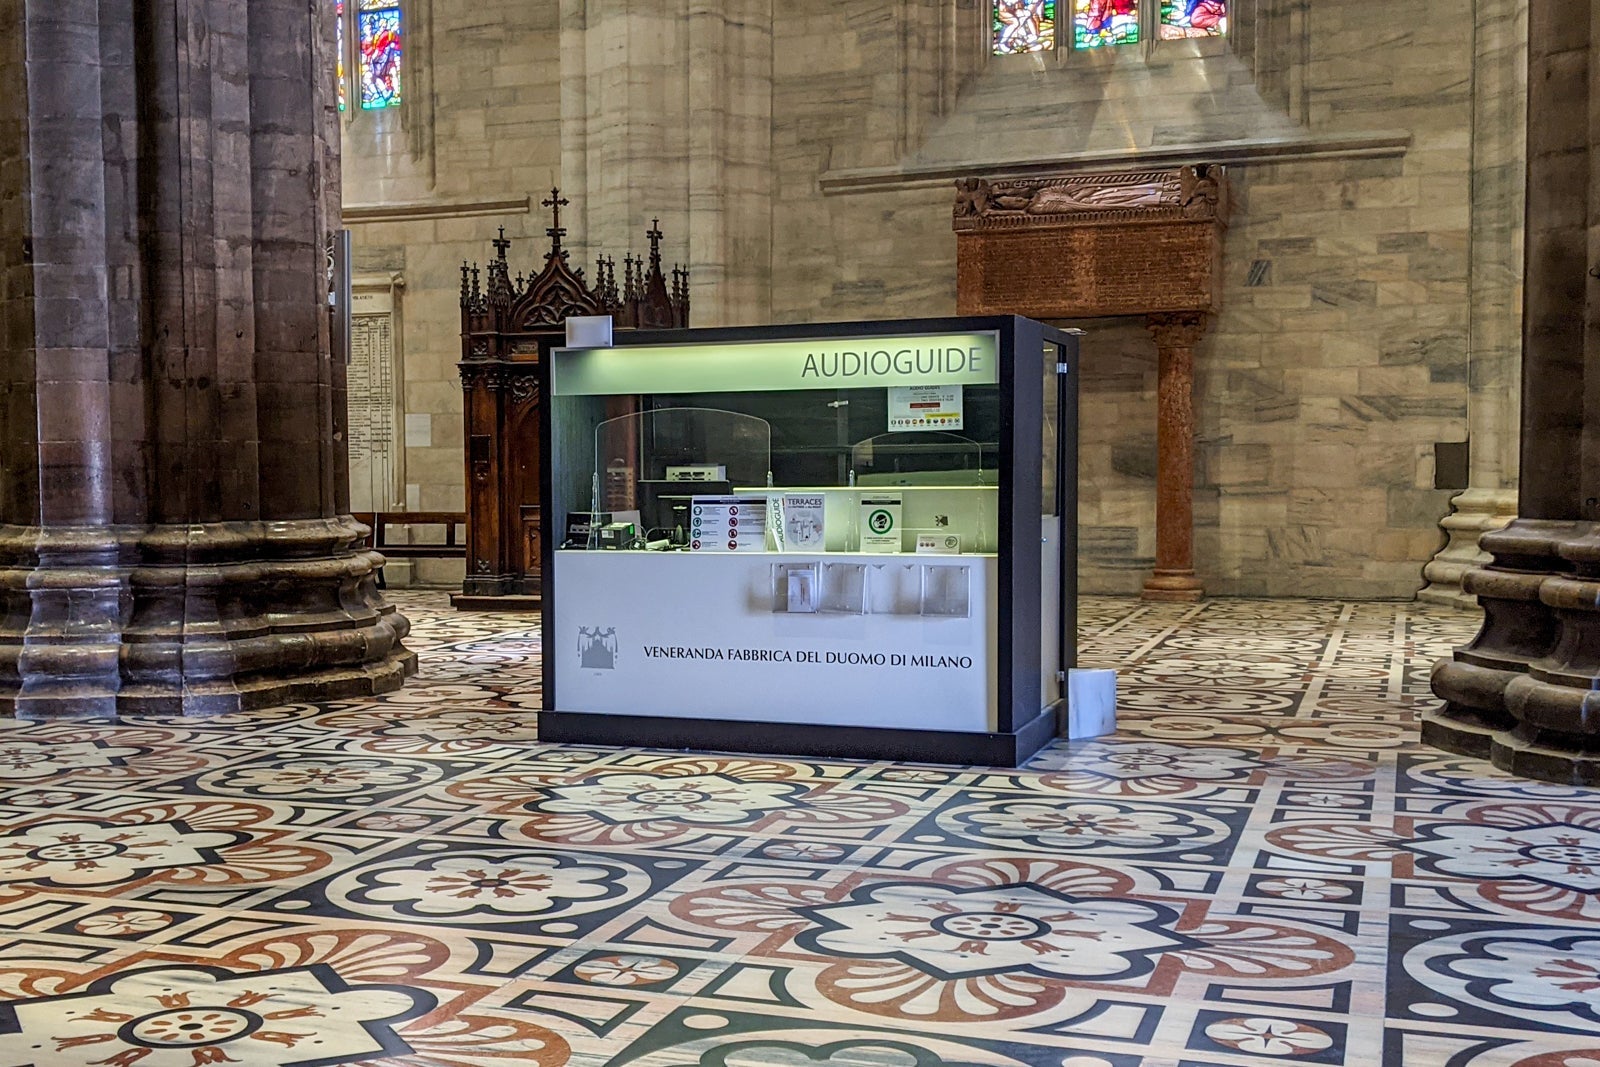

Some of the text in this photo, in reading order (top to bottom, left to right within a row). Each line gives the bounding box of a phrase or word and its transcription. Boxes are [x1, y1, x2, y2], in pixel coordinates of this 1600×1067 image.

[801, 347, 983, 378] AUDIOGUIDE
[788, 498, 822, 506] TERRACES
[772, 498, 784, 543] AUDIOGUIDE
[643, 646, 973, 669] VENERANDA FABBRICA DEL DUOMO DI MILANO
